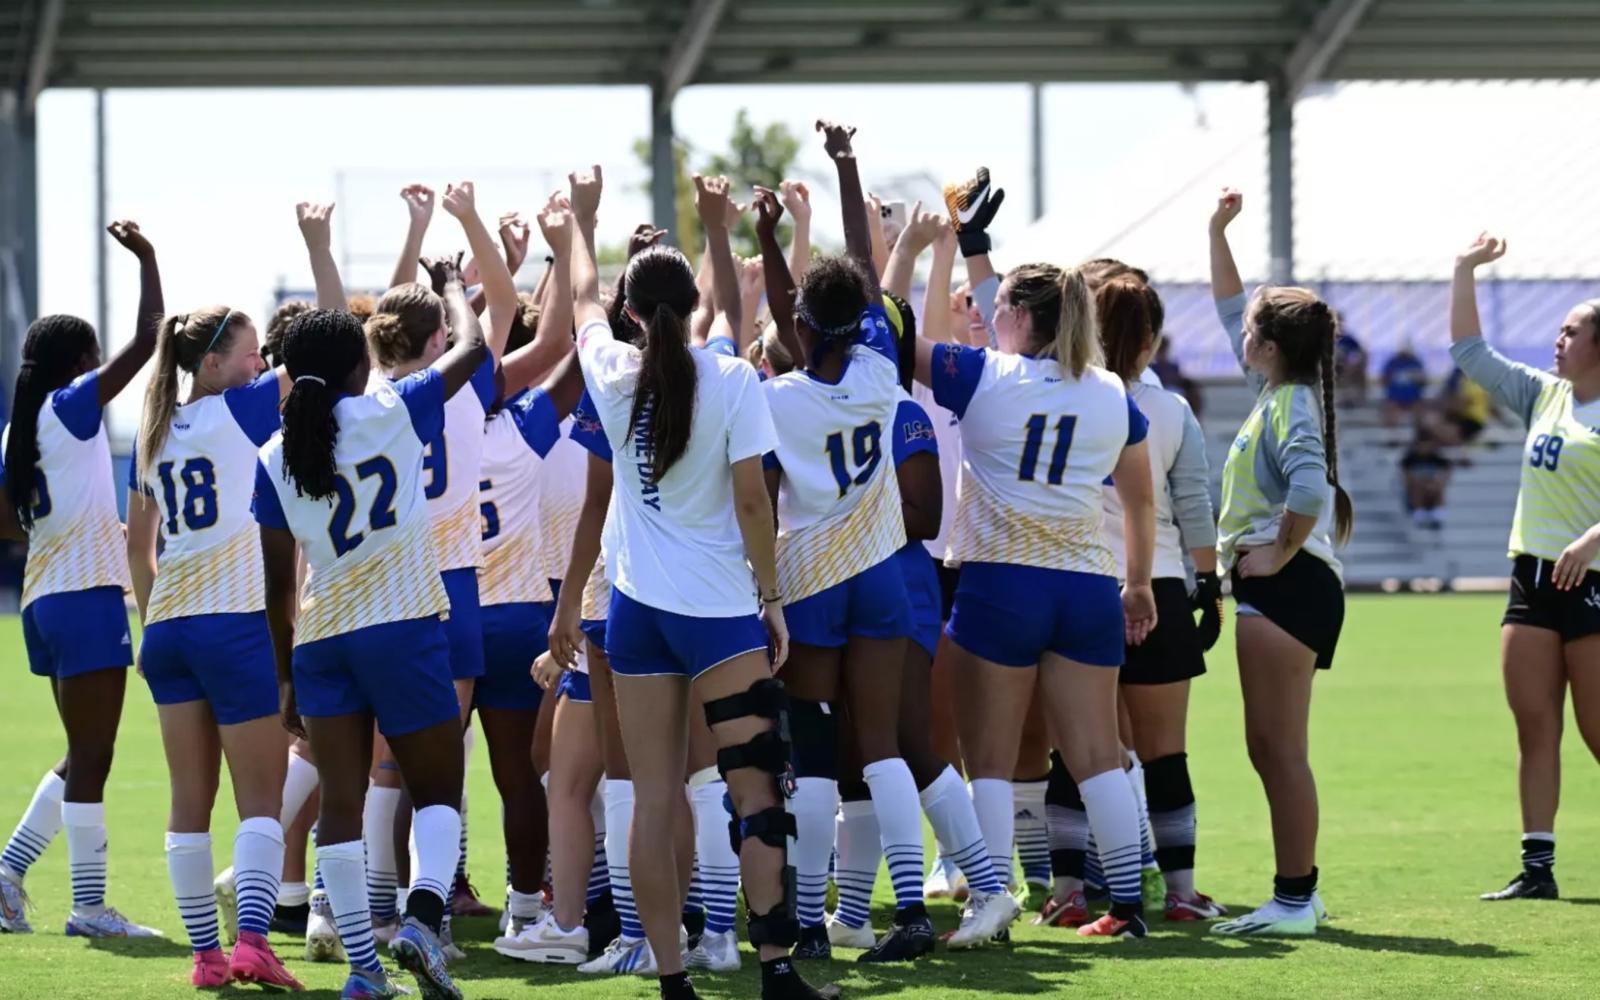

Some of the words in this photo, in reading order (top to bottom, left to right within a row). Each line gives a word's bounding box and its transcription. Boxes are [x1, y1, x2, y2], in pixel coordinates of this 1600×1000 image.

[823, 417, 883, 500] 19
[1018, 411, 1079, 486] 11
[1529, 433, 1564, 472] 99
[157, 456, 219, 535] 18
[327, 453, 399, 559] 22
